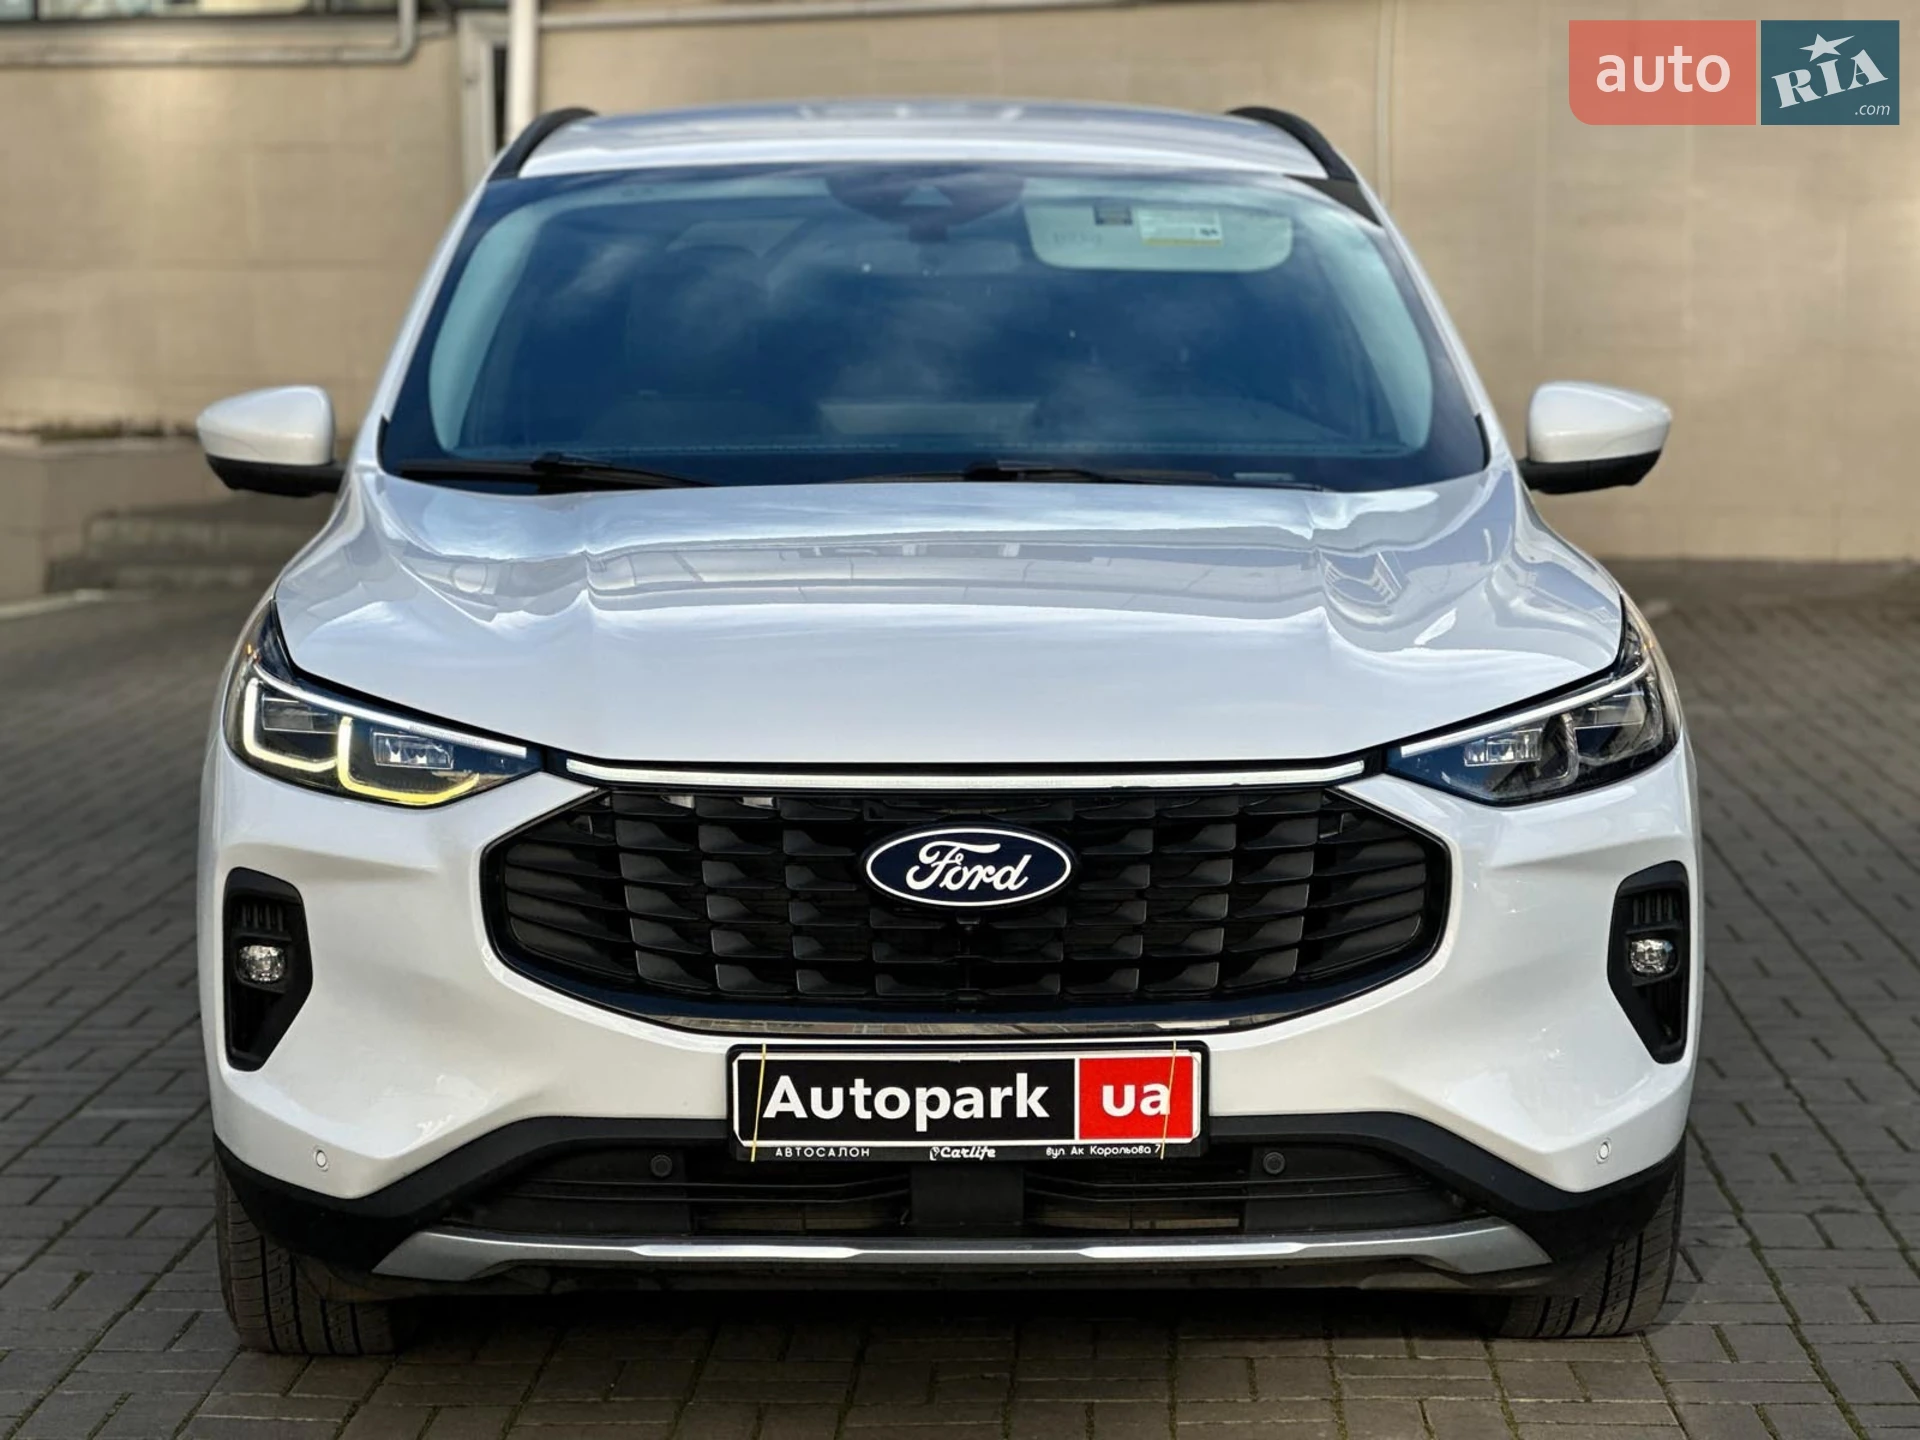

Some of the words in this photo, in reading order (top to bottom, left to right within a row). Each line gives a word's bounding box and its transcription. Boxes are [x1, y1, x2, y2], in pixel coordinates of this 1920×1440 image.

[906, 841, 1032, 891] Ford
[762, 1073, 1050, 1132] Autopark
[1101, 1081, 1170, 1117] ua
[775, 1147, 870, 1158] АВТОСАЛОН
[940, 1146, 996, 1161] Carlife
[1045, 1147, 1065, 1159] вул
[1070, 1146, 1085, 1155] Ак
[1090, 1145, 1151, 1157] Корольова
[1154, 1144, 1161, 1153] 7
